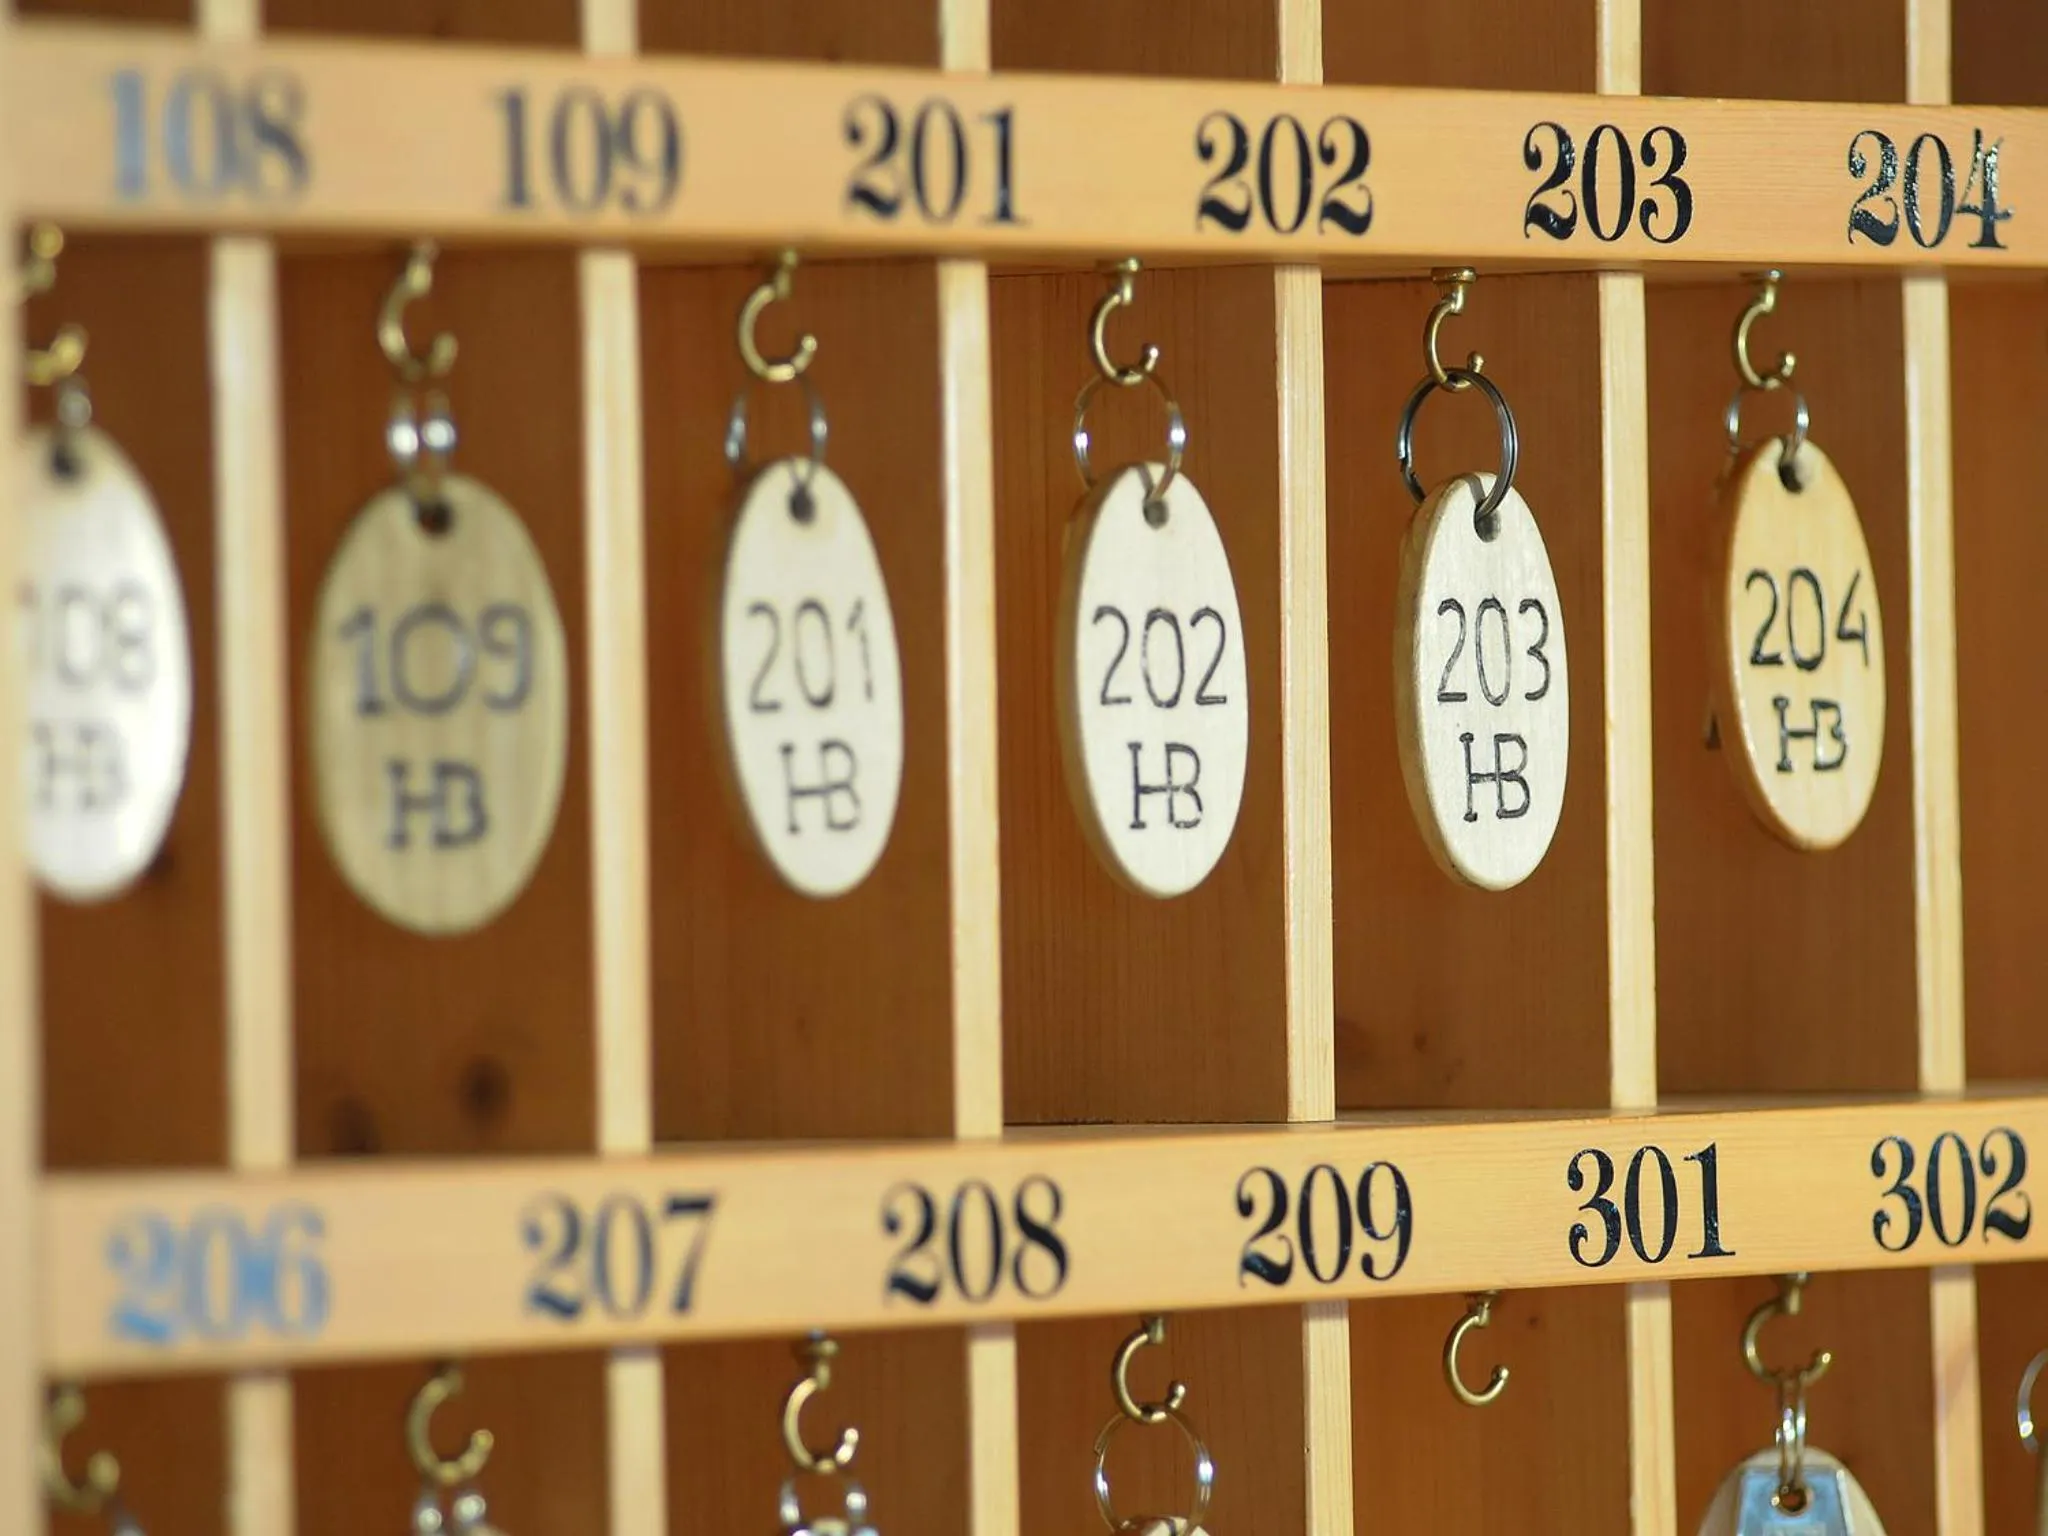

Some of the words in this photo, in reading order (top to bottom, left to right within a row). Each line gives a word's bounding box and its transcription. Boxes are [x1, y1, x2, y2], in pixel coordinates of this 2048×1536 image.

[108, 66, 313, 204] 108
[486, 84, 684, 216] 109
[840, 94, 1030, 228] 201
[1194, 111, 1375, 237] 202
[1523, 121, 1693, 244] 203
[1846, 127, 2015, 250] 204
[336, 600, 536, 718] 109
[746, 596, 876, 714] 201
[1090, 605, 1230, 708] 202
[1435, 597, 1552, 705] 203
[1744, 567, 1872, 671] 204
[780, 738, 864, 836] HB
[1128, 741, 1202, 831] HB
[1459, 732, 1532, 823] HB
[1772, 696, 1850, 774] HB
[384, 758, 490, 852] HB
[880, 1174, 1070, 1306] 208
[1235, 1160, 1414, 1288] 209
[1567, 1141, 1737, 1268] 301
[1870, 1127, 2033, 1252] 302
[104, 1203, 334, 1348] 206
[518, 1190, 722, 1324] 207
